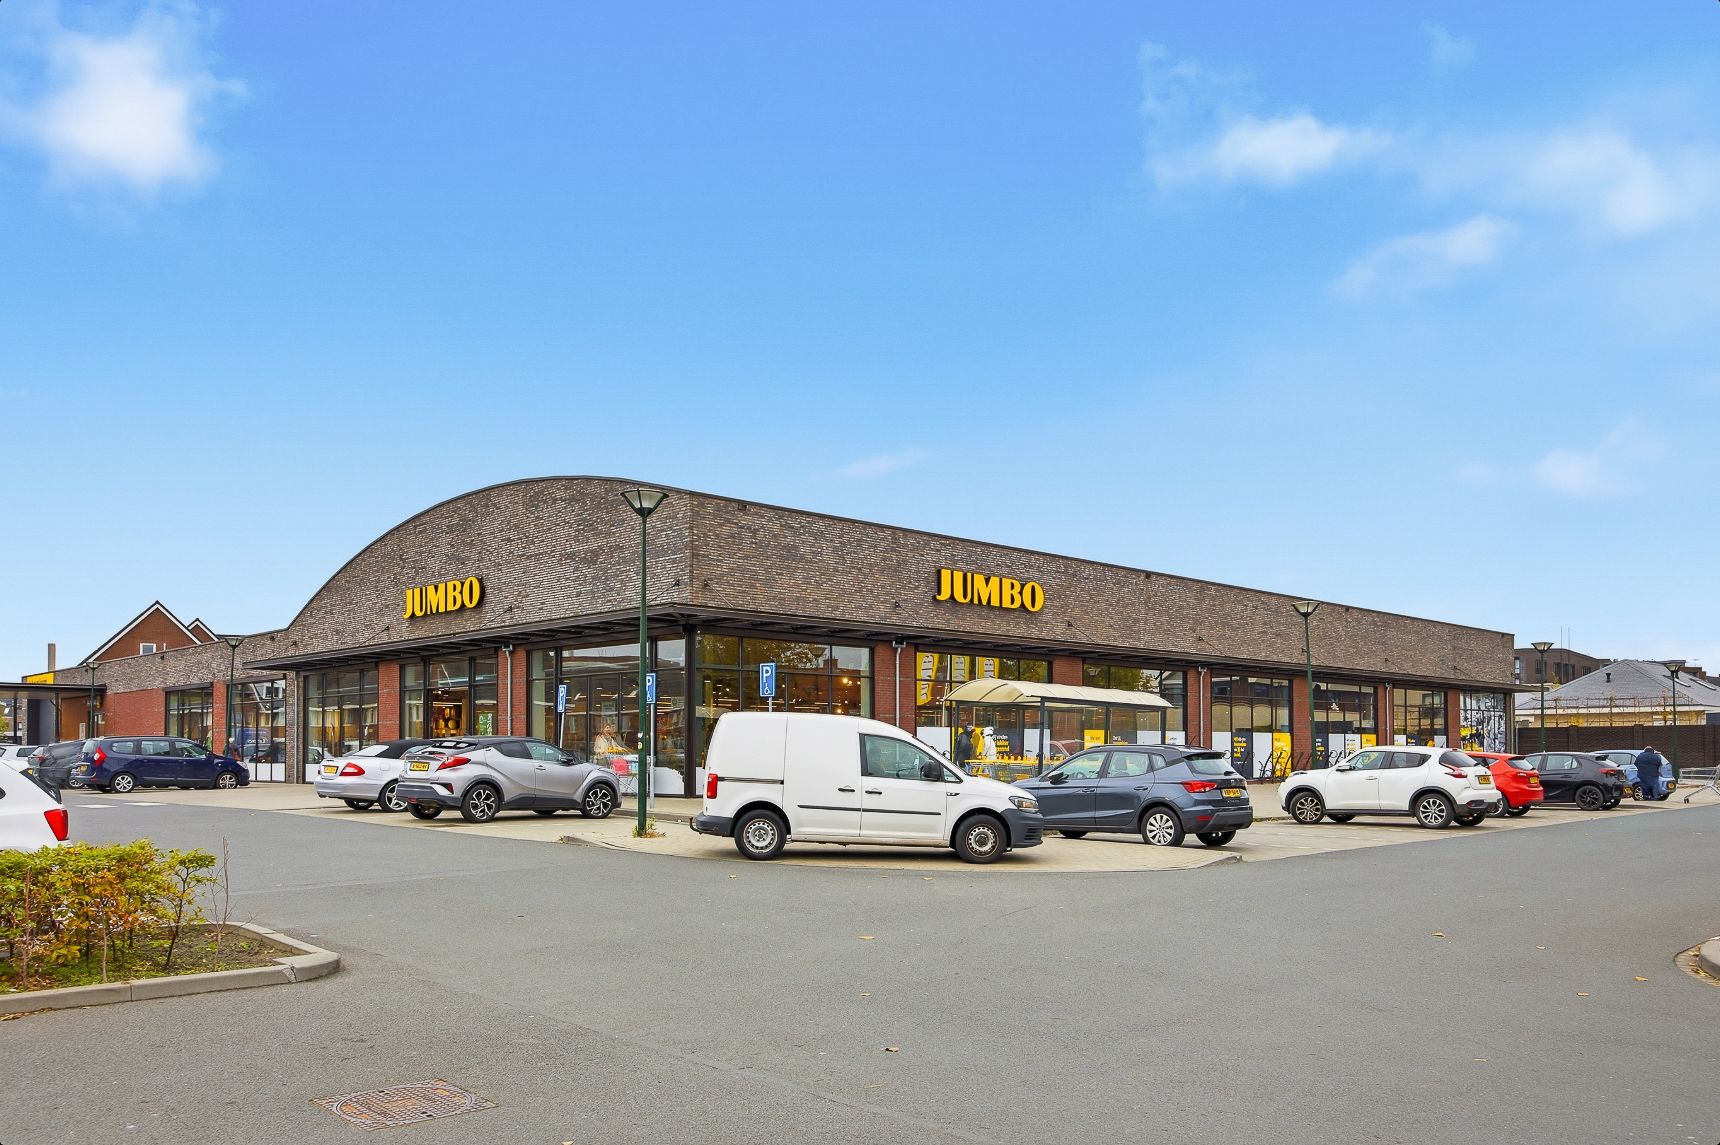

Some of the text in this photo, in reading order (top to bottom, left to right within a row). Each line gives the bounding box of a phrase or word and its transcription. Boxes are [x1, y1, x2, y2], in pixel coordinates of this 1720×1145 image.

[403, 577, 480, 619] JUMBO
[936, 569, 1044, 612] JUMBO
[646, 676, 652, 691] P
[763, 666, 771, 682] P
